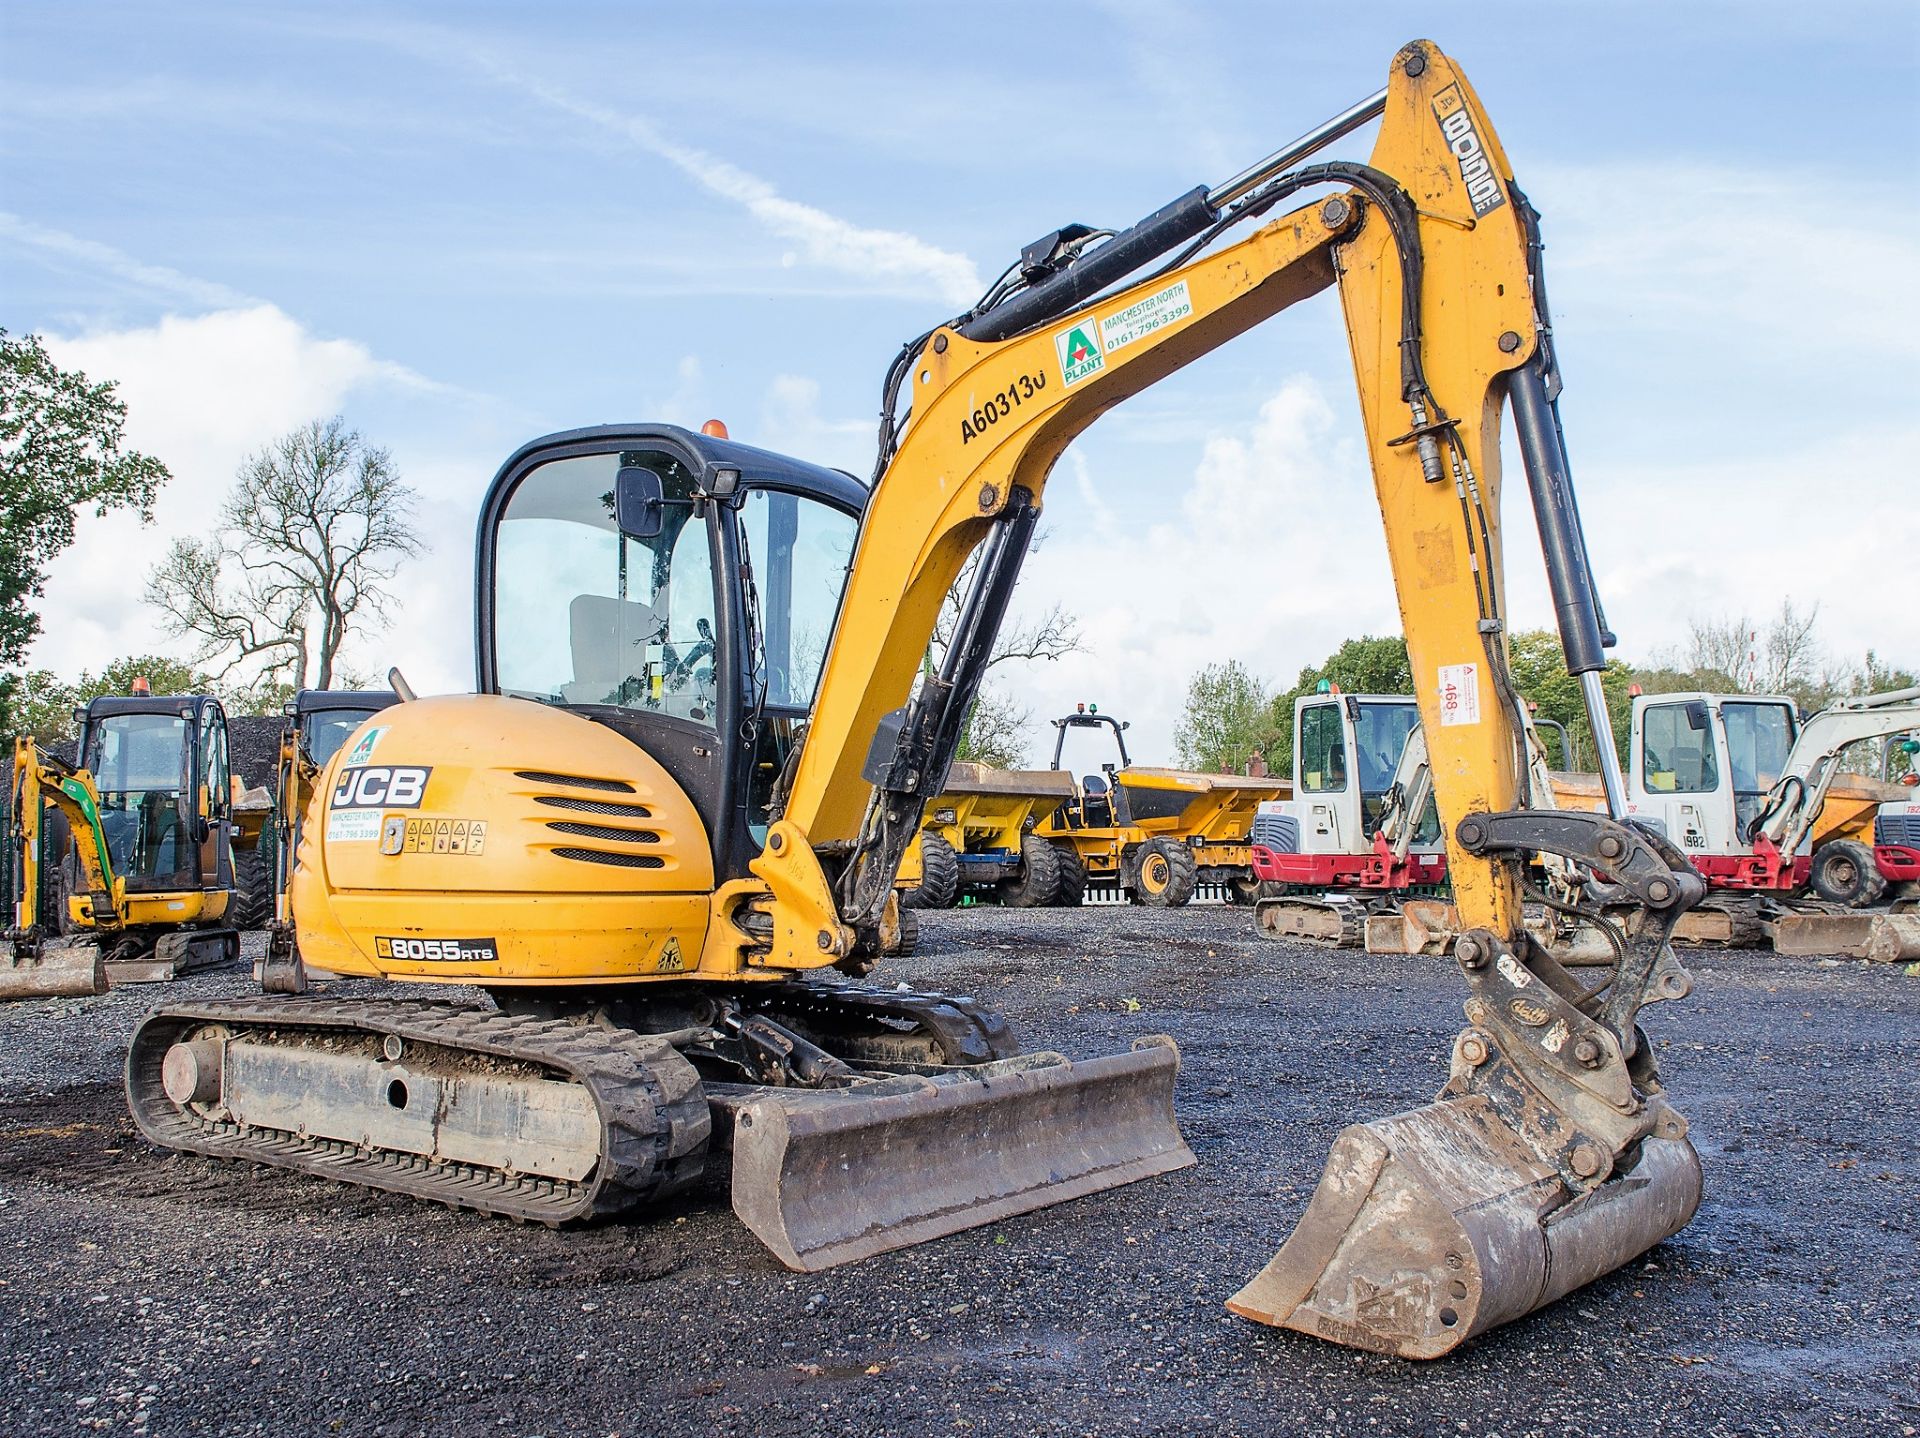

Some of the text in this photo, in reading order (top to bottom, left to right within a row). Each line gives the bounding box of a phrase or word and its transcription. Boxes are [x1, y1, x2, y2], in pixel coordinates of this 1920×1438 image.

[1442, 110, 1498, 203] 8055
[1475, 192, 1501, 213] RTS
[1104, 284, 1185, 331] MANCHESTER NORTH
[1064, 356, 1103, 383] PLANT
[1445, 683, 1457, 710] 468
[333, 768, 427, 806] JCB
[1683, 835, 1705, 848] 1982
